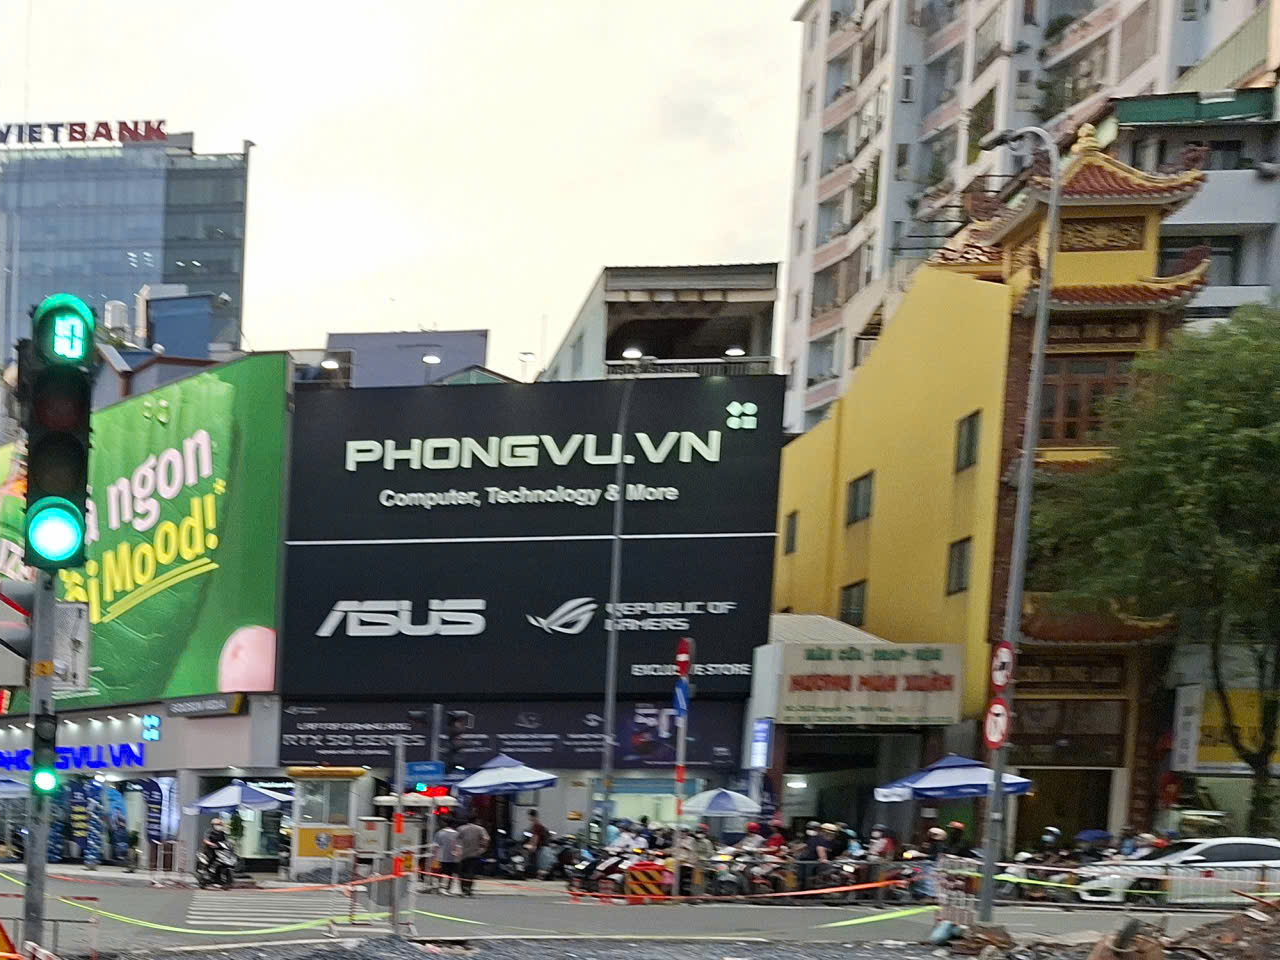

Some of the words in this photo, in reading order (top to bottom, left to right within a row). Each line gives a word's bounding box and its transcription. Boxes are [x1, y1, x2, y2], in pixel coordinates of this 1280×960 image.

[345, 430, 721, 472] PHONGVU.VN
[106, 428, 213, 532] ngon
[379, 488, 481, 509] Computer,
[484, 485, 601, 506] Technology
[604, 484, 620, 501] &
[625, 484, 679, 501] More
[316, 599, 486, 637] ASUS
[605, 602, 705, 617] REPUBLIC
[707, 602, 738, 613] OF
[604, 618, 690, 631] GAMERS
[354, 734, 426, 746] SERES
